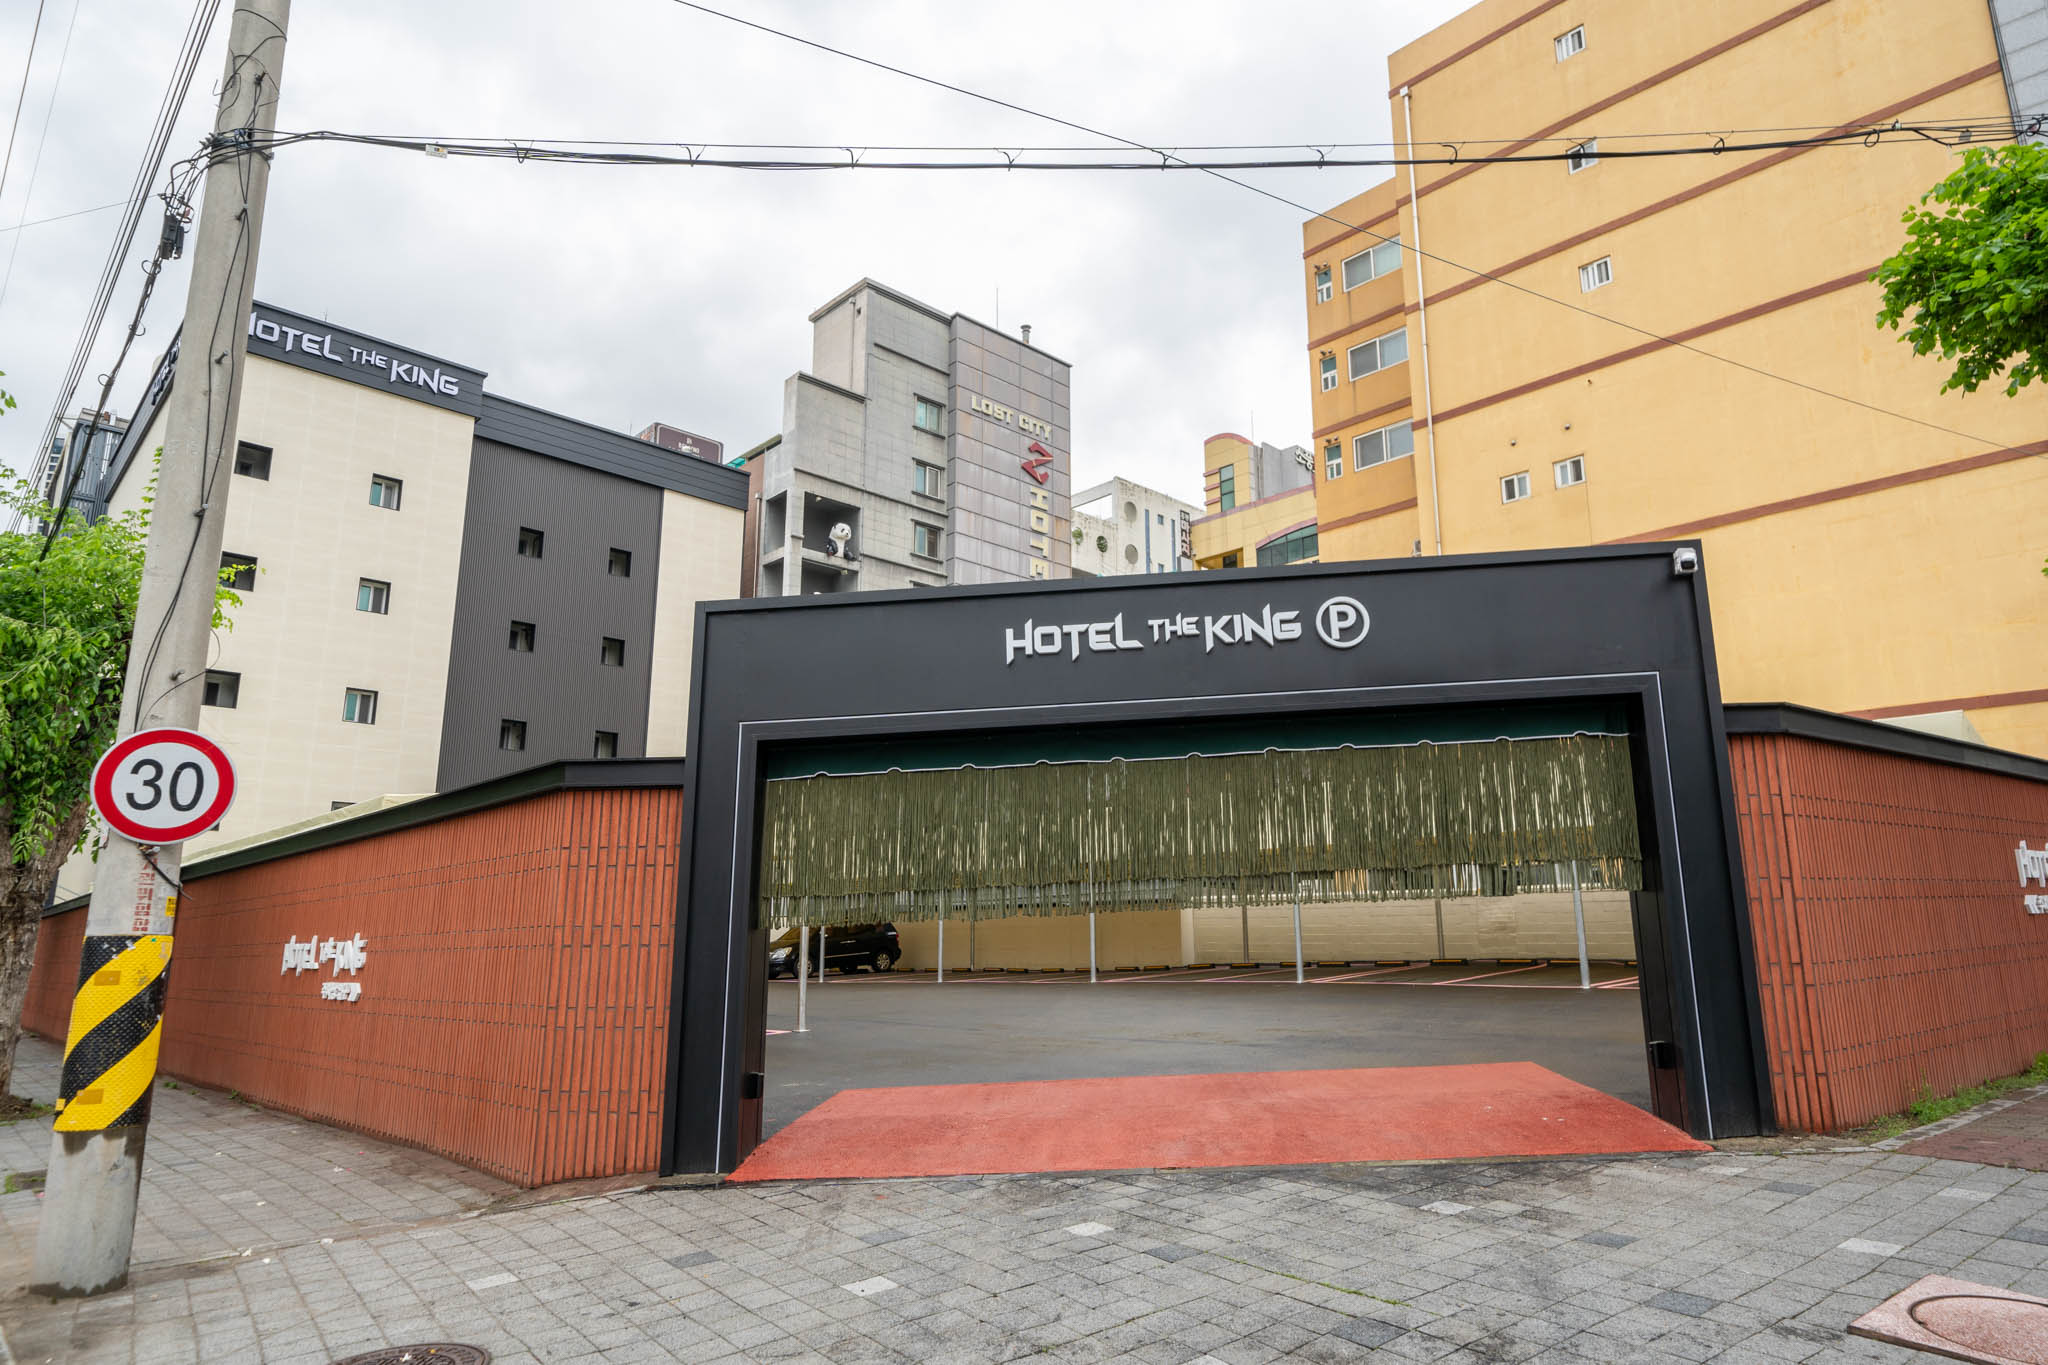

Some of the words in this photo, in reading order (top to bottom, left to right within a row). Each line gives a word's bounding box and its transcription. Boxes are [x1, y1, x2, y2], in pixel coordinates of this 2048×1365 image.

[349, 346, 388, 369] THE
[390, 359, 459, 396] KING
[971, 395, 1013, 424] LOST
[1018, 414, 1052, 440] CITY
[1005, 612, 1144, 665] HOTEL
[1148, 612, 1200, 644] THE
[1204, 603, 1302, 654] KING
[125, 758, 205, 812] 30
